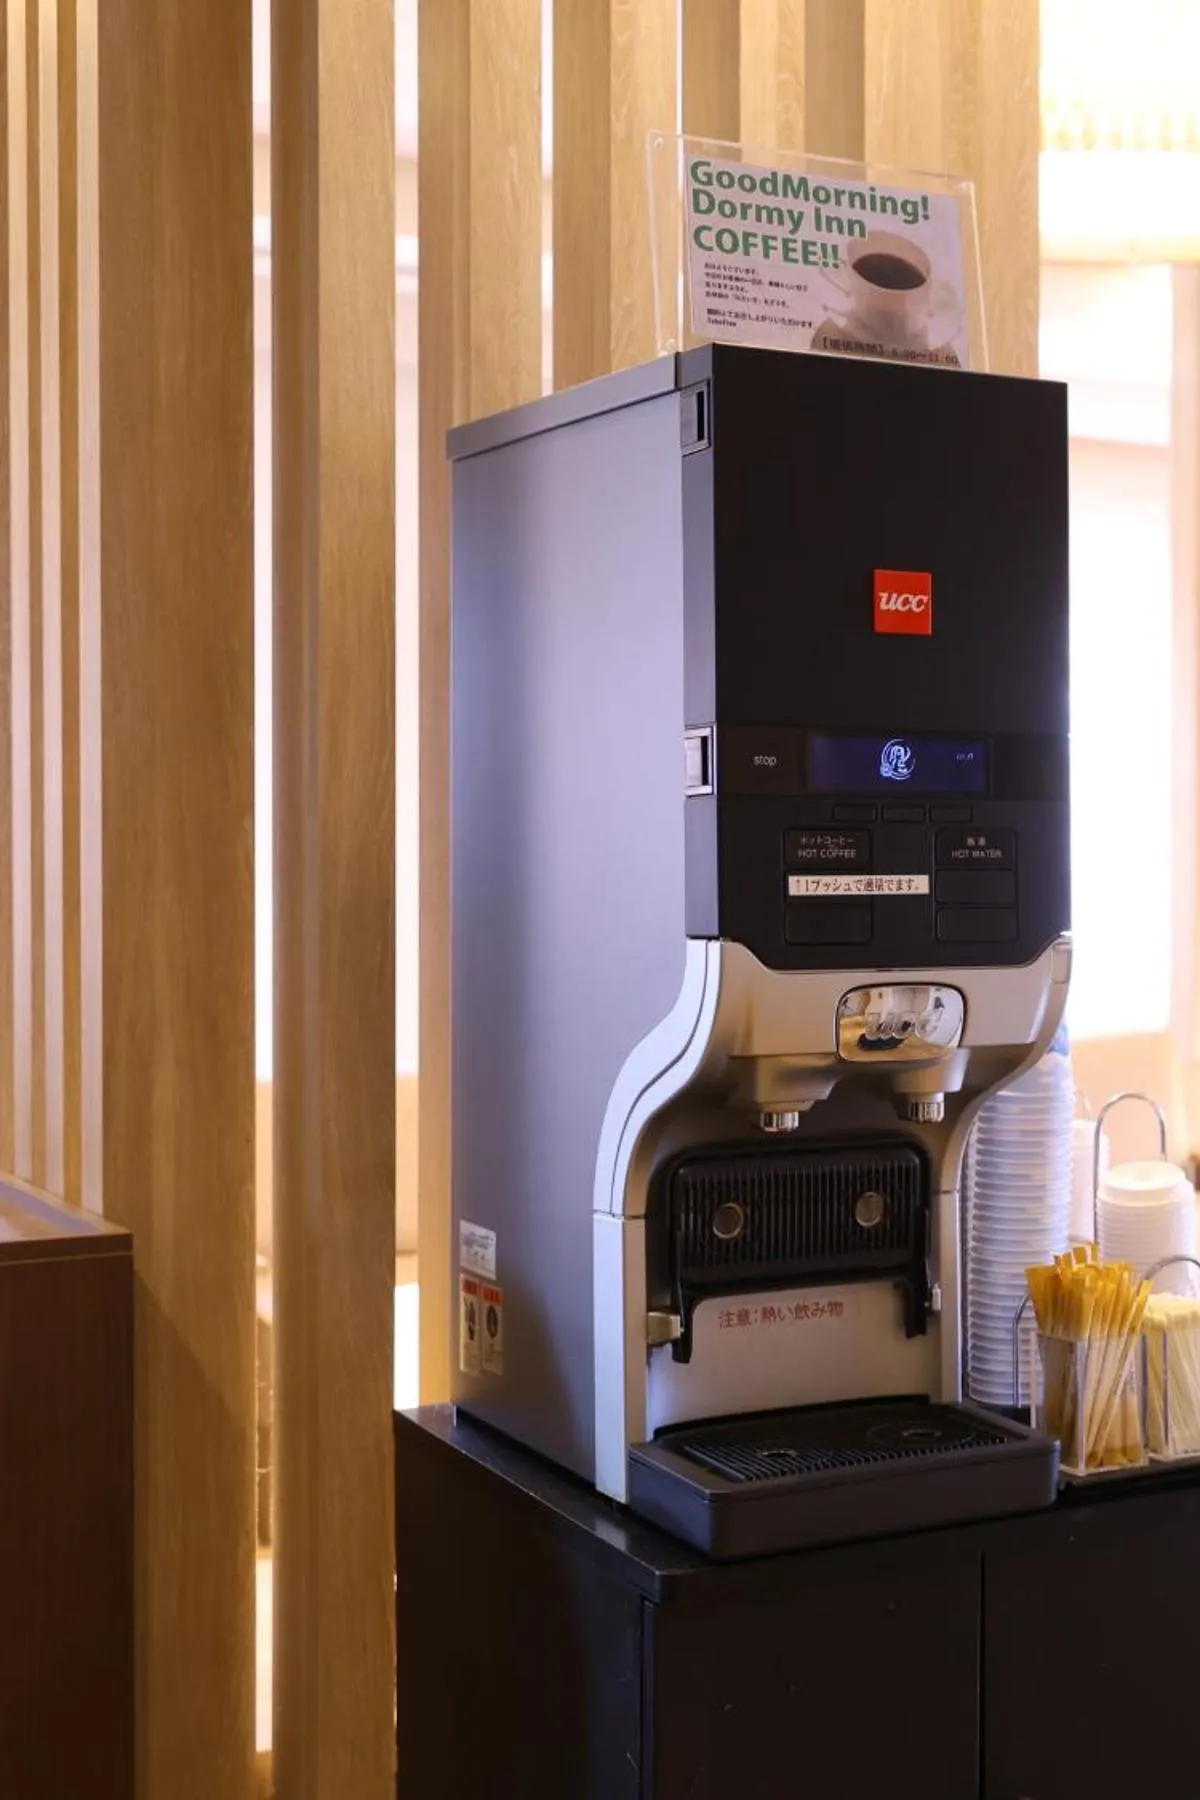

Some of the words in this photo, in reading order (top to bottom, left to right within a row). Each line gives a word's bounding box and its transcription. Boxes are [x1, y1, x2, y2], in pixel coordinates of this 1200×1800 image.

[690, 160, 930, 225] GoodMorning!
[691, 188, 804, 235] Dormy
[814, 206, 867, 239] Inn
[693, 224, 840, 269] COFFEE!!
[753, 754, 777, 767] stop
[798, 849, 817, 859] HOT
[820, 849, 857, 859] COFFEE
[951, 849, 969, 859] HOT
[972, 849, 1003, 859] WATER
